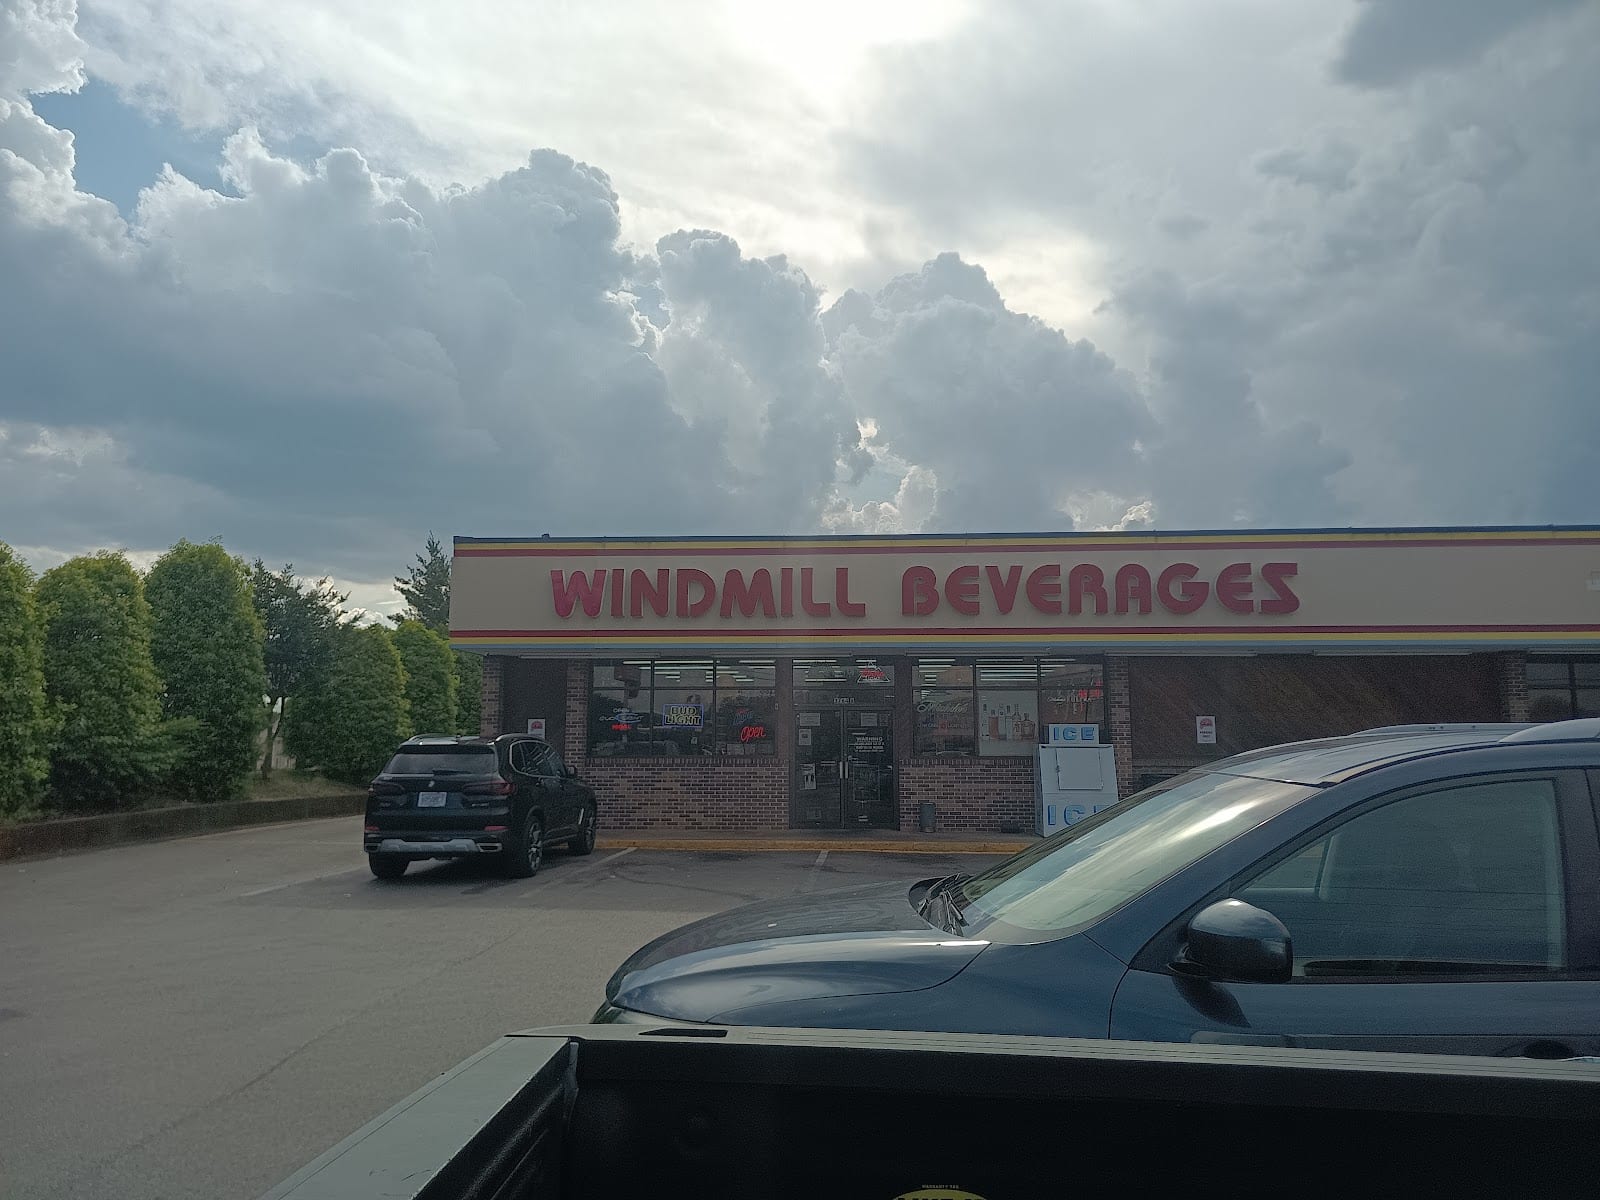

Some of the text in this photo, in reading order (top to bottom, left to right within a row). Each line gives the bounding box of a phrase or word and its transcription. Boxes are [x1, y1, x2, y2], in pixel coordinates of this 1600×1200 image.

[551, 561, 1301, 619] WINDMILL BEVERAGES
[671, 706, 696, 715] BUD
[665, 715, 701, 725] LIGHT
[740, 726, 766, 742] Open
[1053, 726, 1095, 741] ICE
